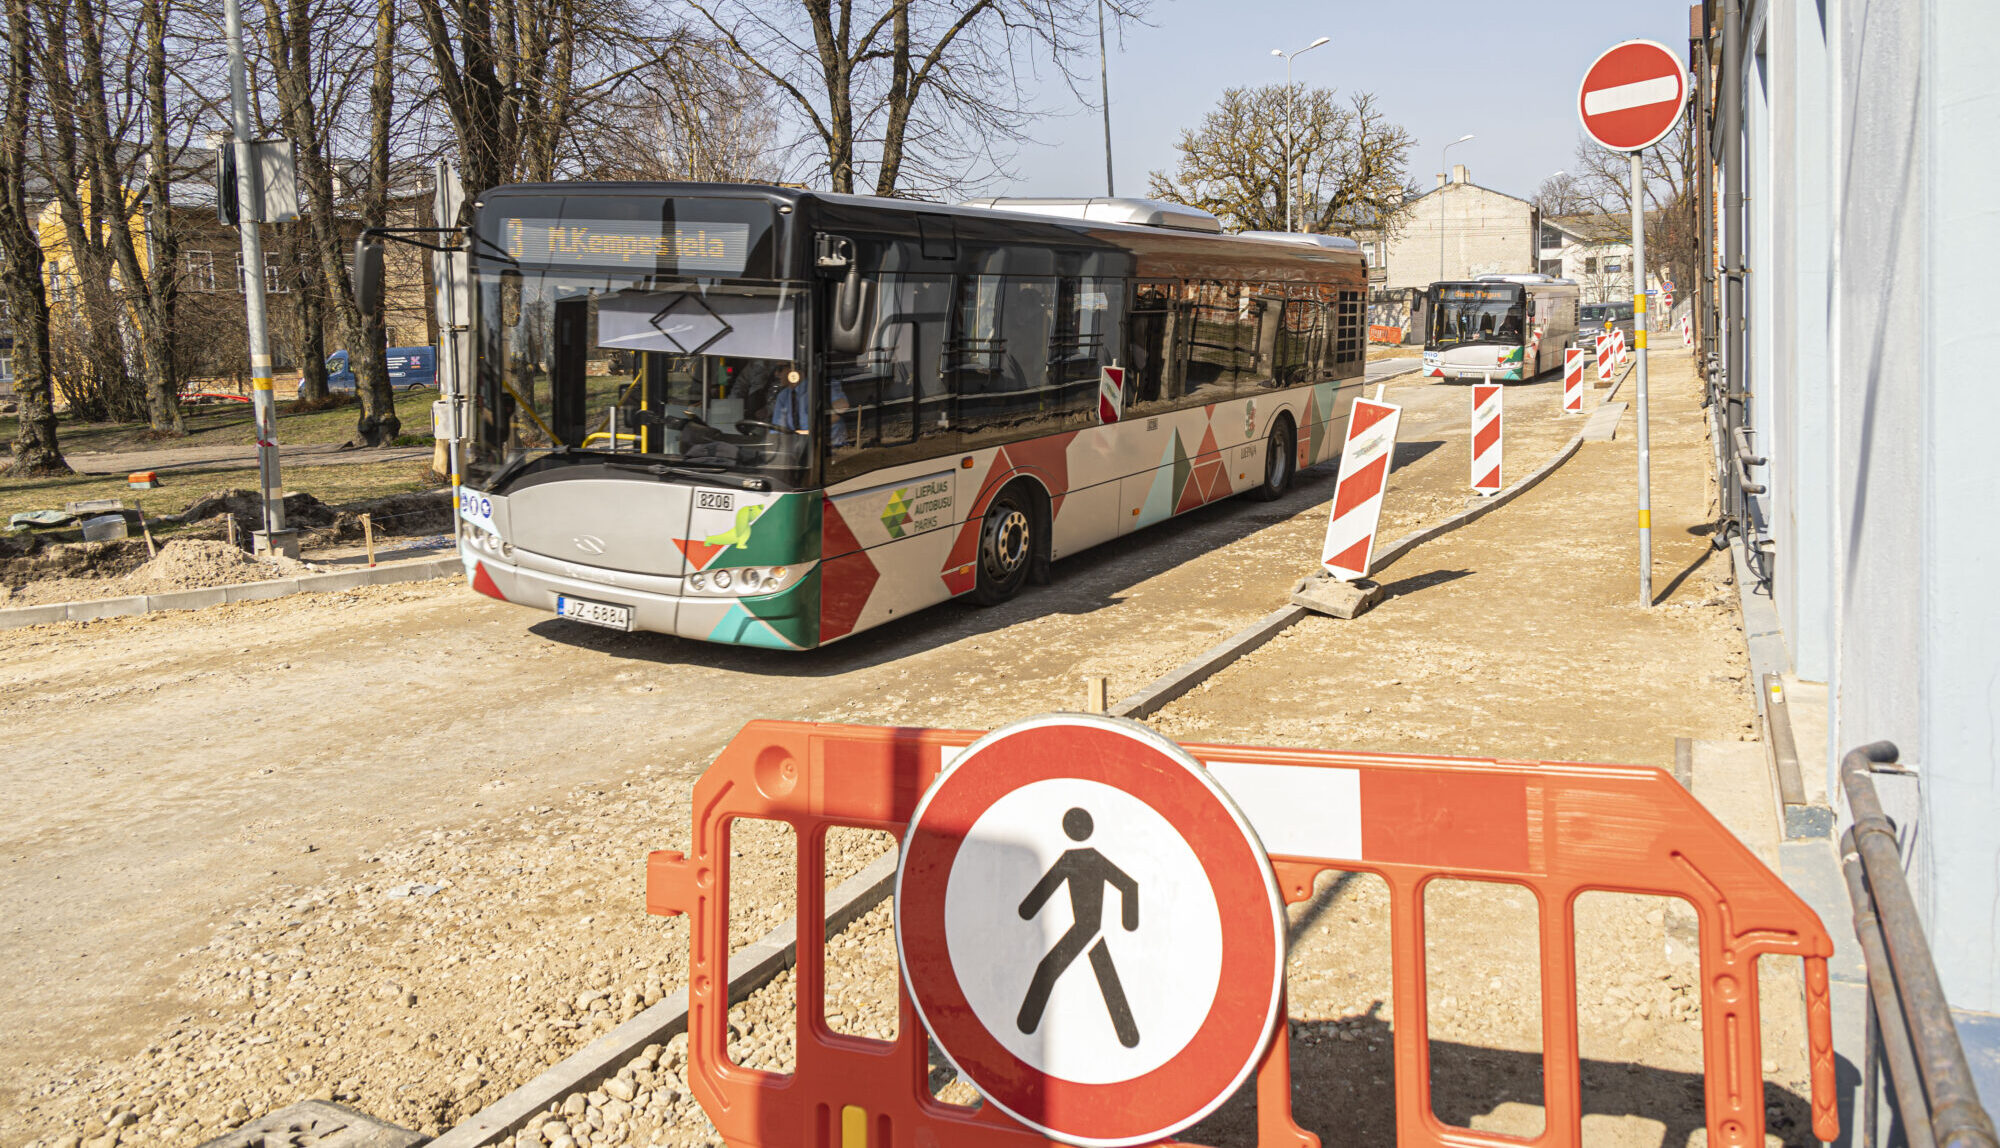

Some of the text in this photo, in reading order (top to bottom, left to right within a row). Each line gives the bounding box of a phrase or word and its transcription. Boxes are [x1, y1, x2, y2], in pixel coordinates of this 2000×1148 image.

[507, 218, 524, 258] 3
[674, 230, 725, 259] iela
[914, 481, 949, 499] LIEPĀJAS
[700, 493, 731, 509] 8206
[914, 496, 952, 515] AUTOBUSU
[913, 516, 938, 533] PARKS
[567, 602, 625, 624] JZ-6884
